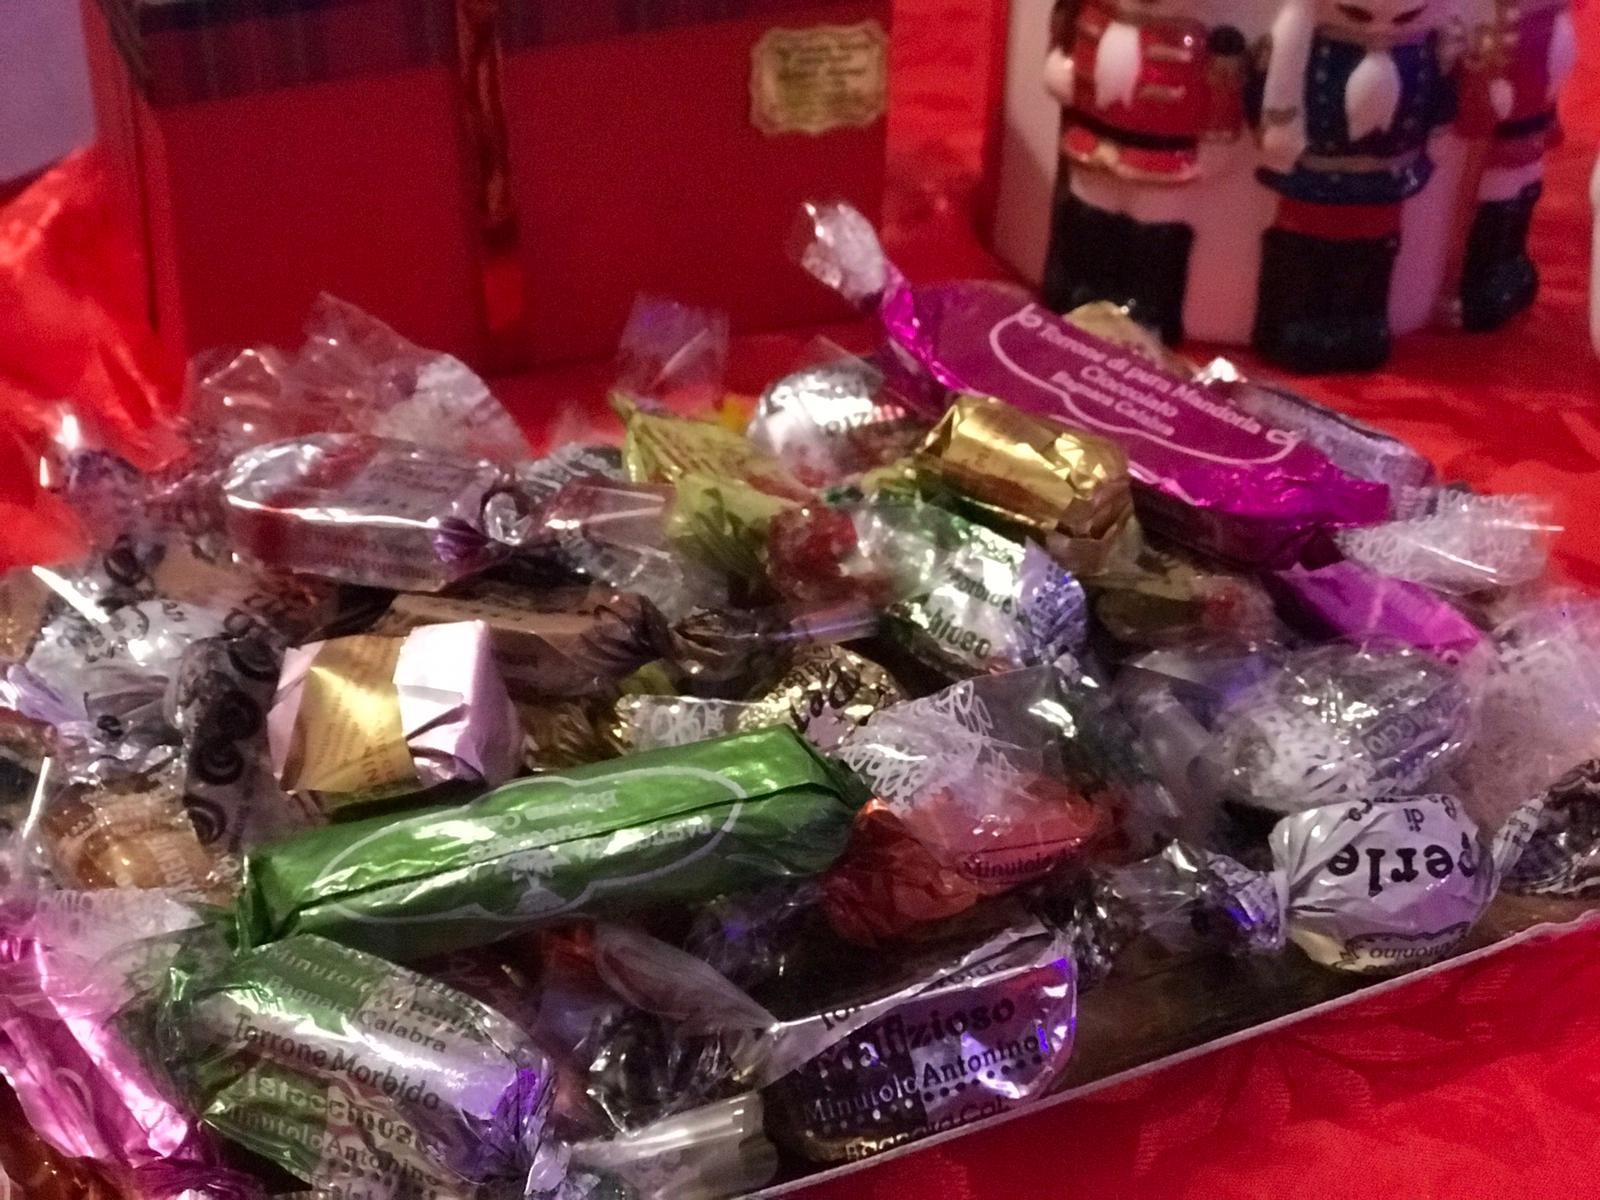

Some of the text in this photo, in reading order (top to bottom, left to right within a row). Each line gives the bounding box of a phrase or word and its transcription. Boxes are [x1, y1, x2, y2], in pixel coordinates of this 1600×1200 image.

[1327, 834, 1475, 897] Perle
[358, 1008, 448, 1053] Calabra
[329, 1047, 444, 1110] Morbido
[801, 1033, 1043, 1125] Minutolo Antonino
